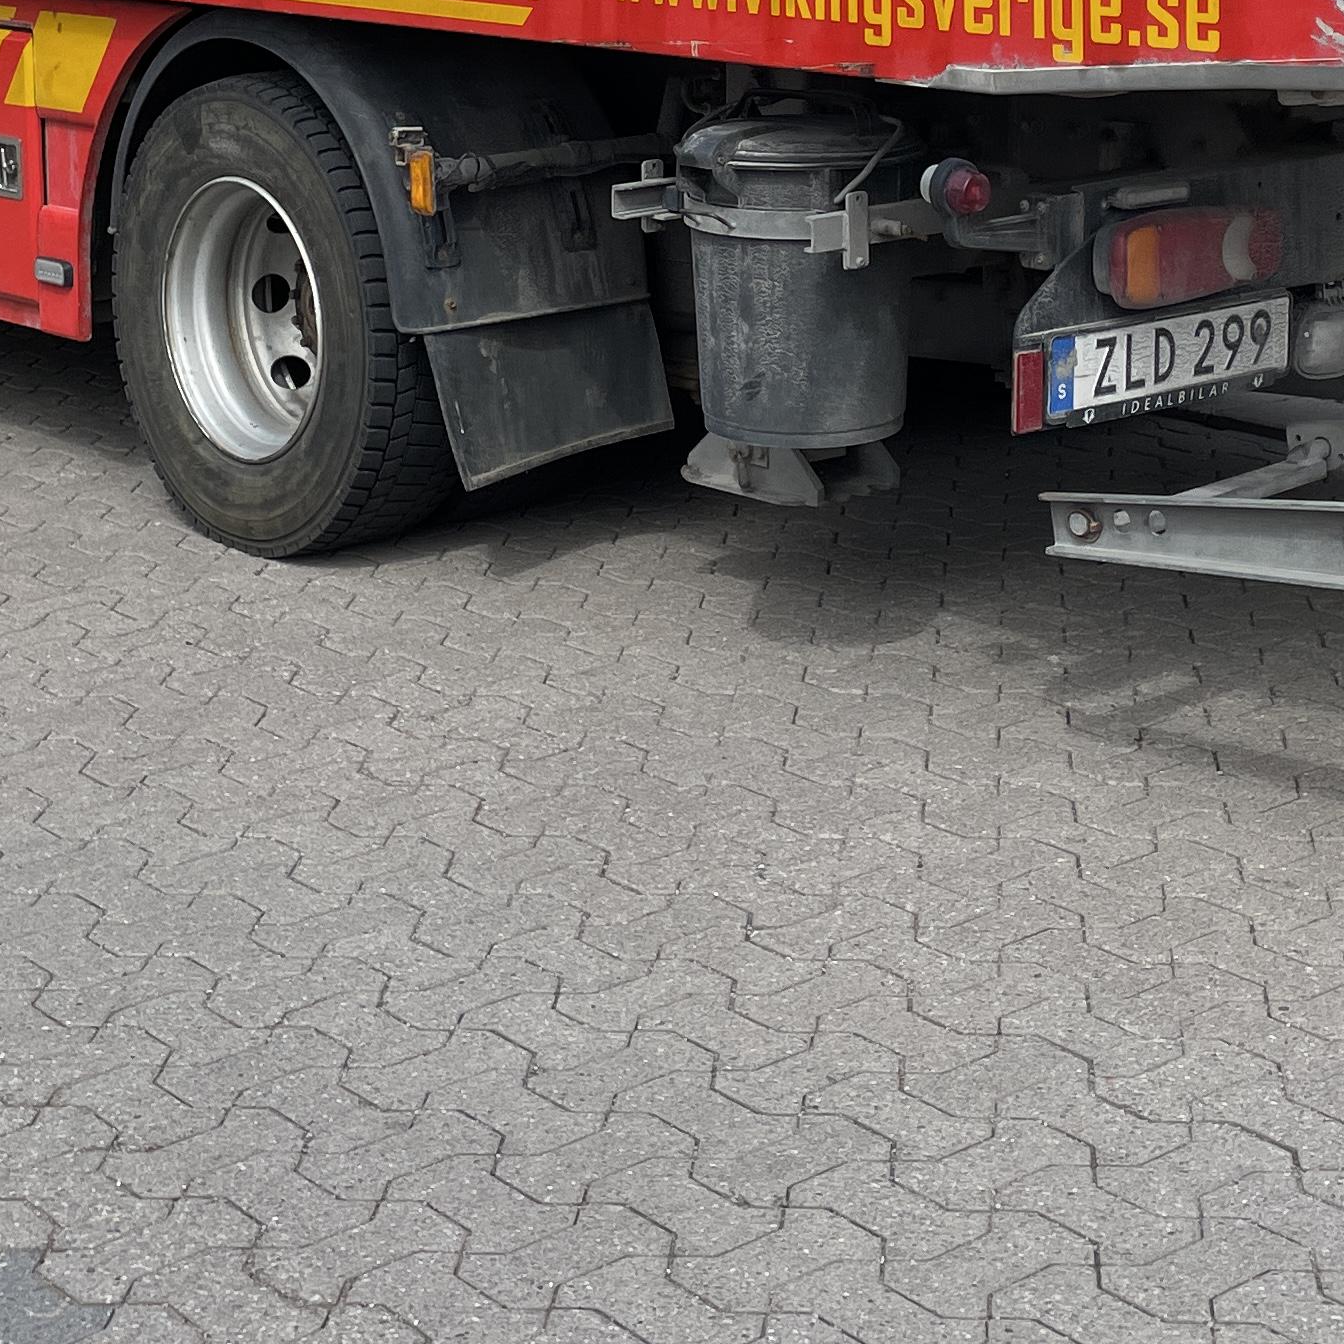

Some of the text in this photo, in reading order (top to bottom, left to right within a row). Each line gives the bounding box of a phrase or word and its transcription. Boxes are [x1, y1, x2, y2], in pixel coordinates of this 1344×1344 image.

[1093, 309, 1272, 398] ZLD 299
[1057, 383, 1067, 400] S
[1122, 382, 1230, 416] IDEALBILAR
